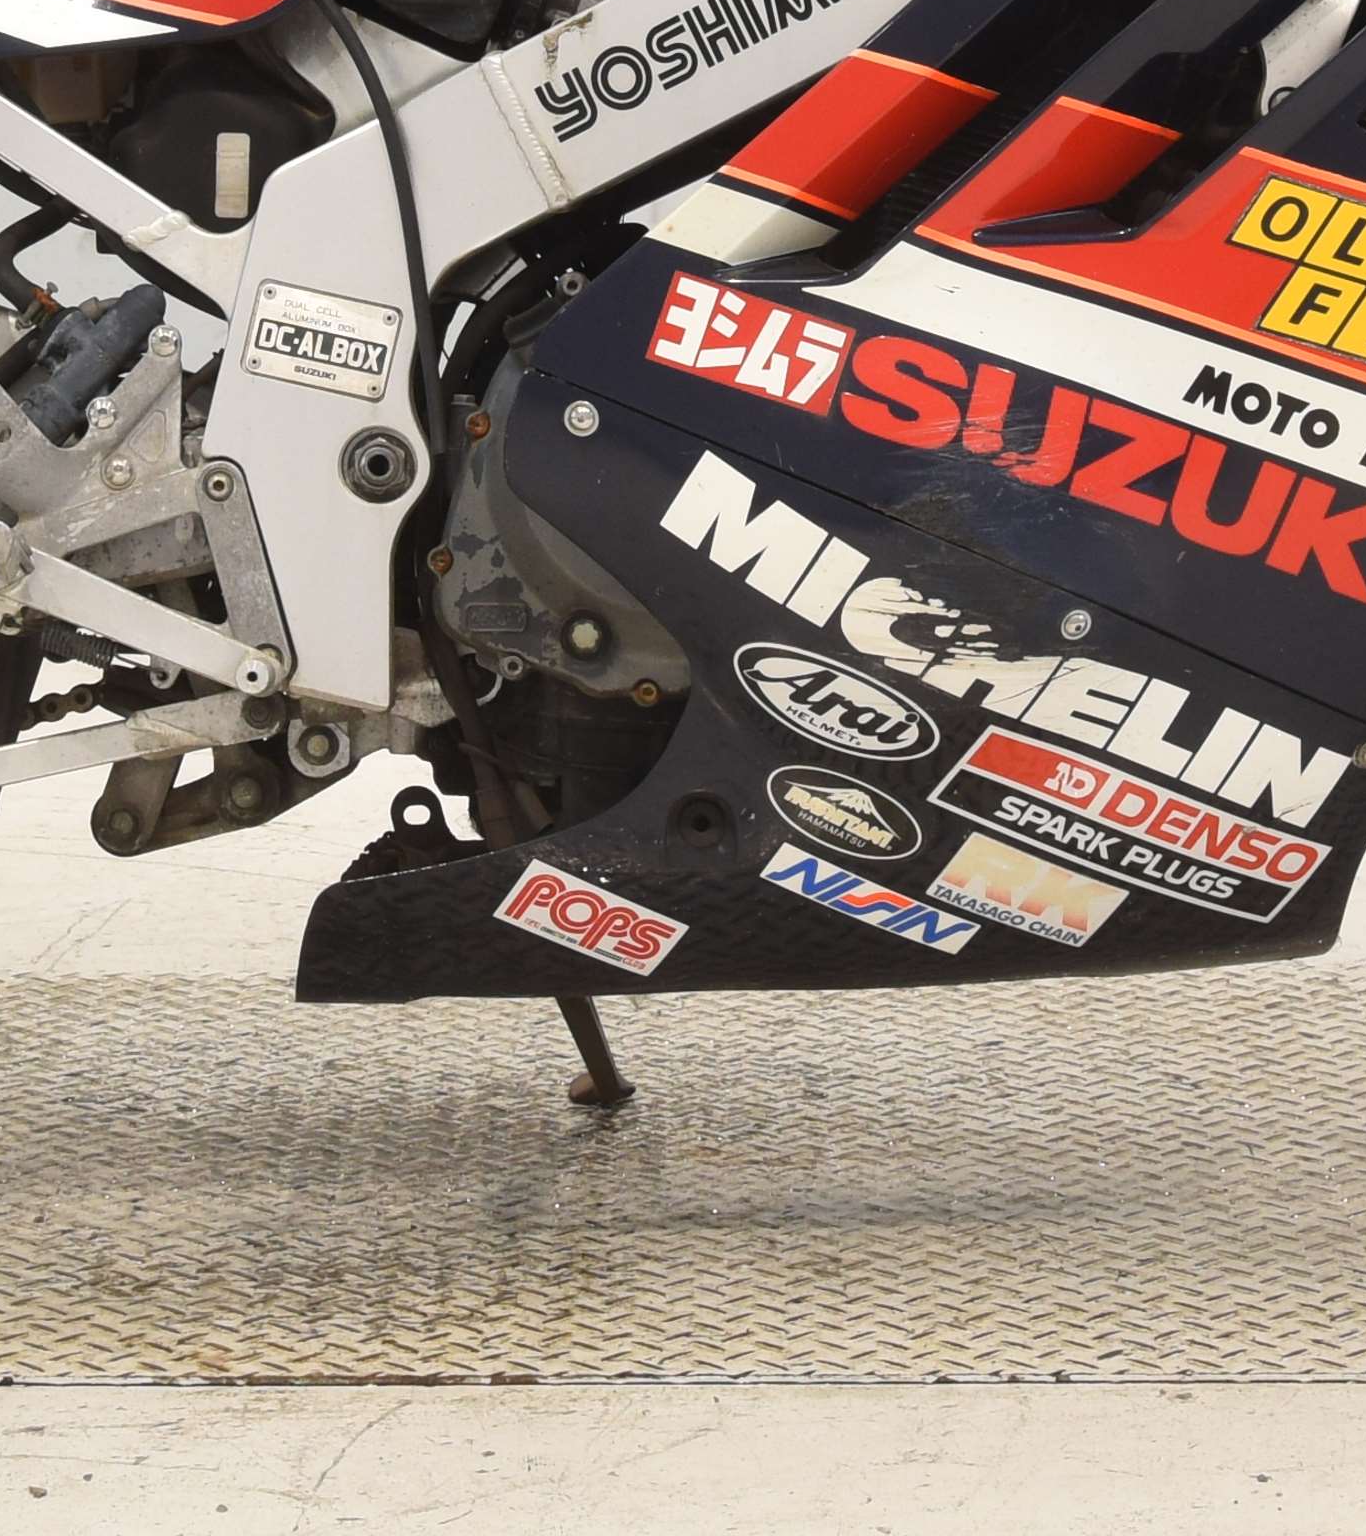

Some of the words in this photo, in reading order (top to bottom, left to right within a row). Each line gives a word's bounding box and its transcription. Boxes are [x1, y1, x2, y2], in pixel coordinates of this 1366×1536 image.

[294, 365, 337, 381] SUZUKI
[653, 276, 847, 405] ヨシムラ
[1183, 363, 1341, 449] MOTO
[659, 449, 1353, 829] MICHELIN
[743, 669, 920, 745] Arai
[786, 705, 858, 745] HELMET
[797, 810, 867, 849] HAMAMATSU
[993, 794, 1121, 860] SPARK
[1120, 845, 1242, 900] PLUGS
[1099, 779, 1318, 883] DENSO
[933, 884, 1026, 926] TAKASAGO
[1028, 920, 1085, 946] CHAIN
